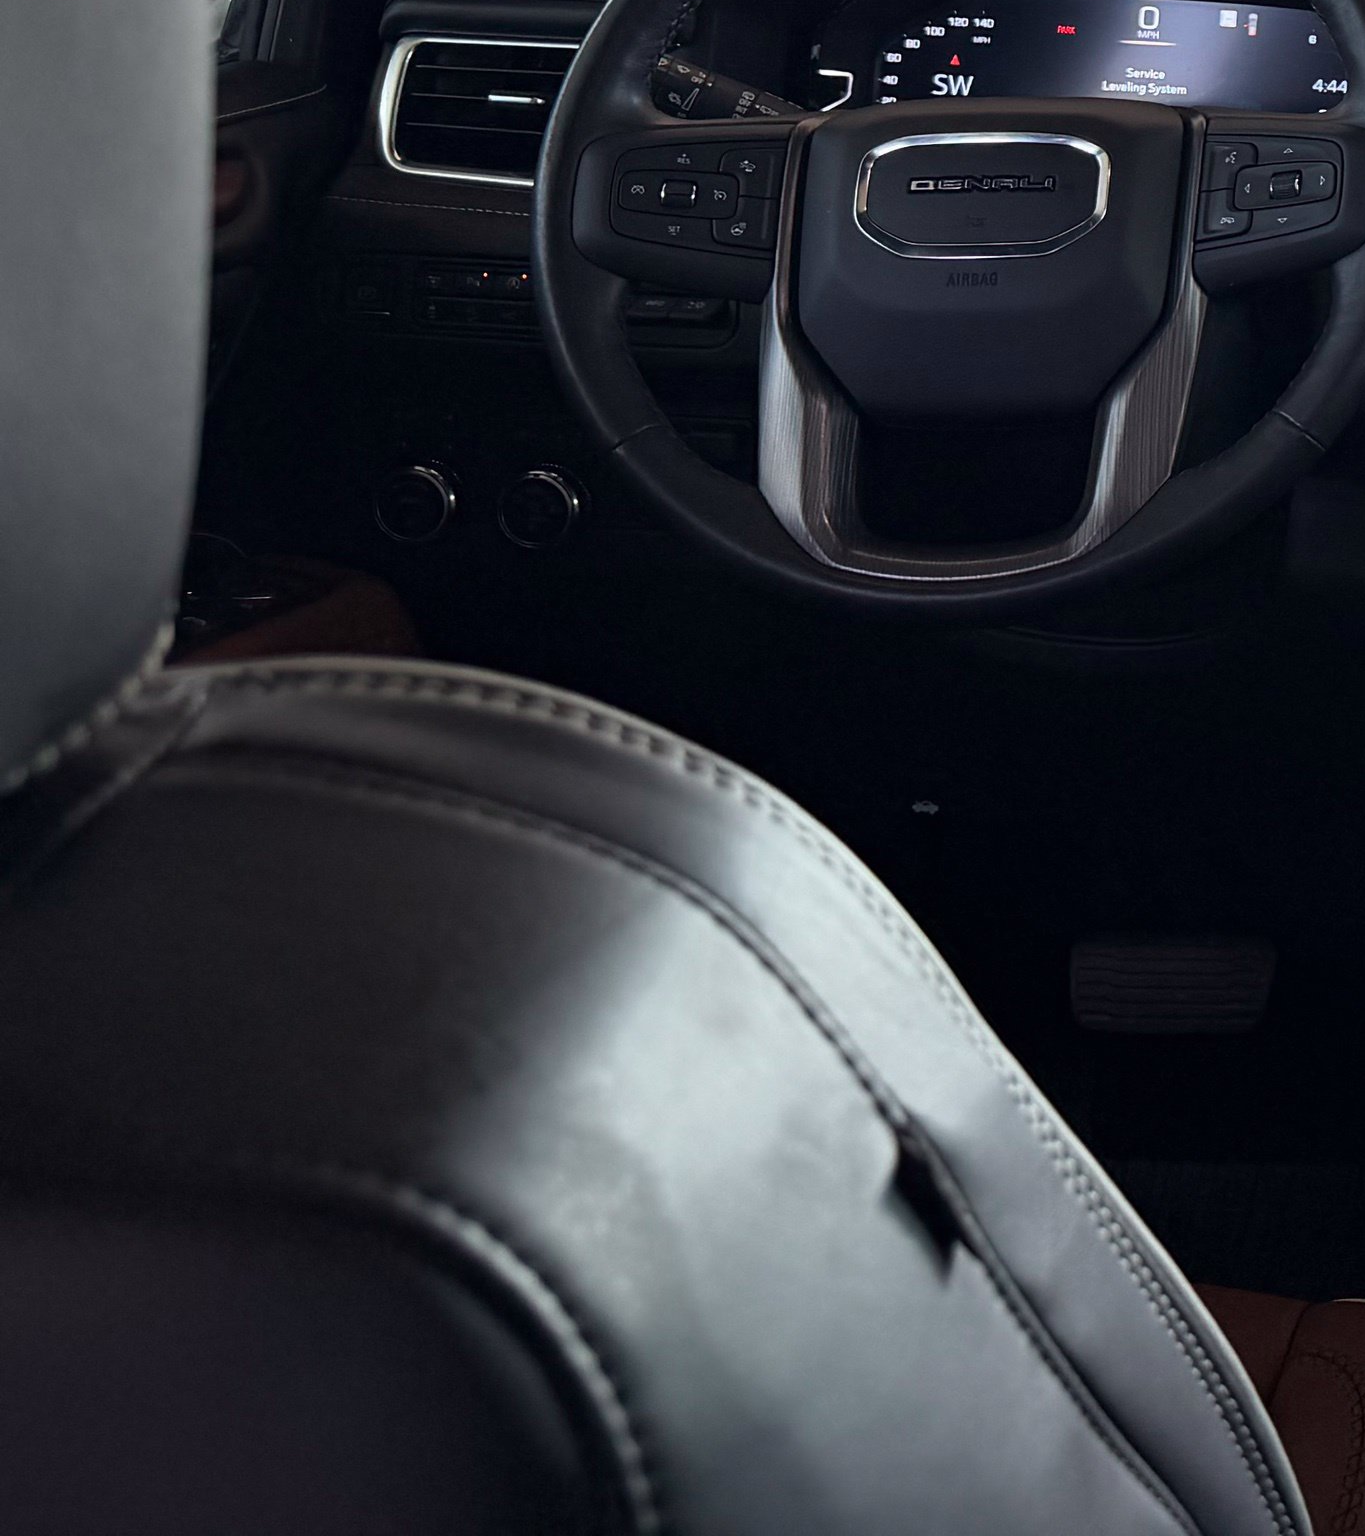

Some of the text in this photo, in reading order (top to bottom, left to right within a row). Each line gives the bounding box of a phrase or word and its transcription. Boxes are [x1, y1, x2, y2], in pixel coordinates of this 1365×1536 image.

[947, 17, 995, 29] 120 140
[1138, 5, 1160, 30] 0
[923, 26, 945, 36] 100
[1137, 30, 1160, 40] MPH
[881, 75, 899, 85] 40
[1125, 67, 1166, 80] Service
[930, 73, 975, 96] SW
[1101, 80, 1188, 96] Leveling System
[1312, 79, 1348, 94] 4:44
[909, 176, 1055, 192] DENALI
[946, 272, 998, 287] AIRBAG
